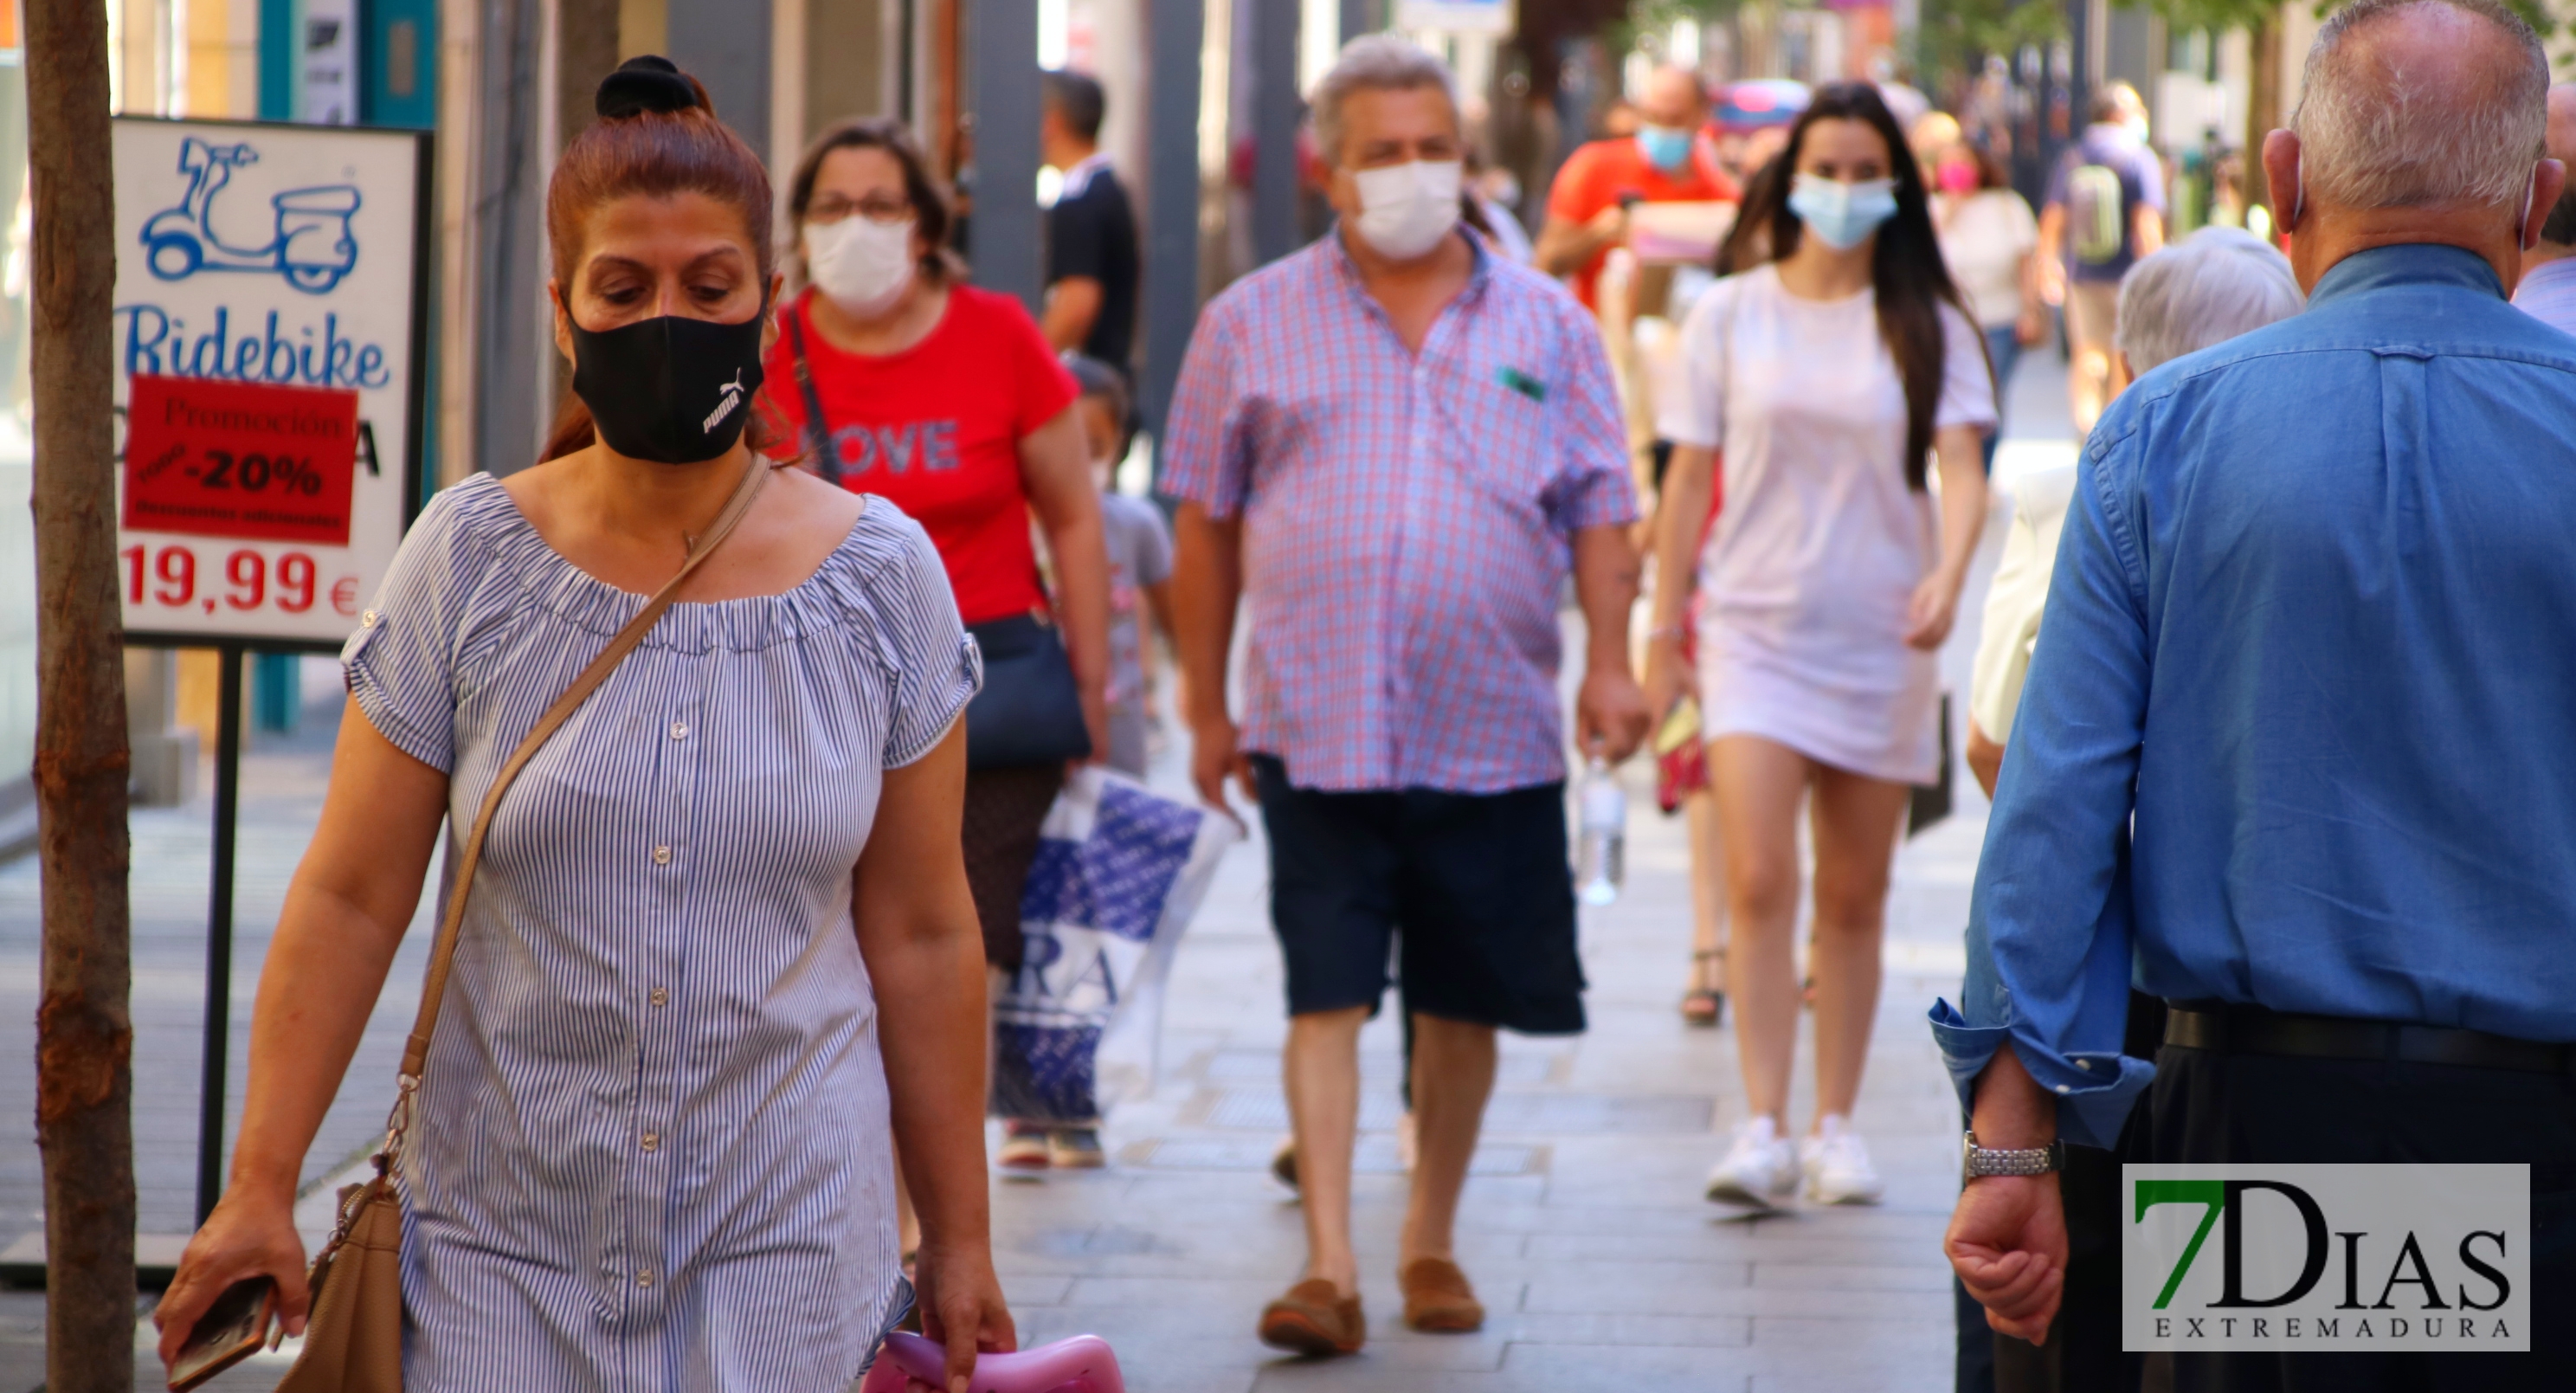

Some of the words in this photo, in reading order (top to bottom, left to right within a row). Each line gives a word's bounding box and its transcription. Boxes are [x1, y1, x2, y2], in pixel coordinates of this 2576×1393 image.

[113, 305, 390, 389] Ridebike
[164, 397, 343, 439] Promoción
[703, 390, 740, 434] PUMA
[184, 448, 321, 497] -20%
[119, 544, 316, 615] 19,99
[330, 577, 359, 616] €
